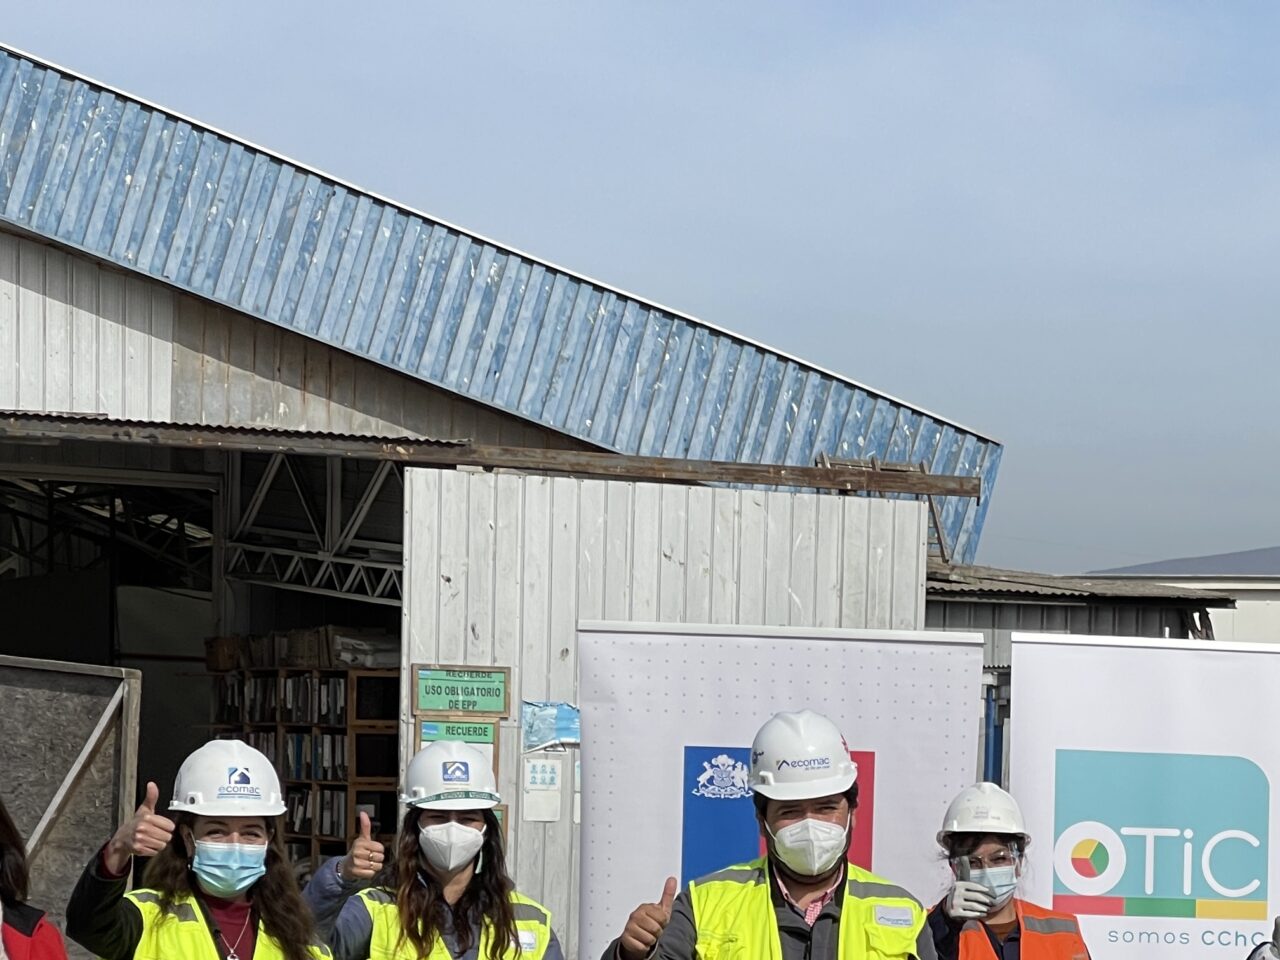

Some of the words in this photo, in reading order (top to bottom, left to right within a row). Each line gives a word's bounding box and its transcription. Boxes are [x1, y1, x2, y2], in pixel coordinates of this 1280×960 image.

[425, 685, 442, 695] USO
[445, 687, 501, 697] OBLIGATORIO
[448, 700, 459, 709] DE
[461, 700, 478, 710] EPP
[445, 726, 489, 737] RECUERDE
[791, 757, 830, 768] ecomac
[218, 785, 261, 795] ecomac
[1054, 820, 1261, 898] OTiC
[1108, 930, 1190, 944] somos
[1201, 930, 1265, 947] CChC
